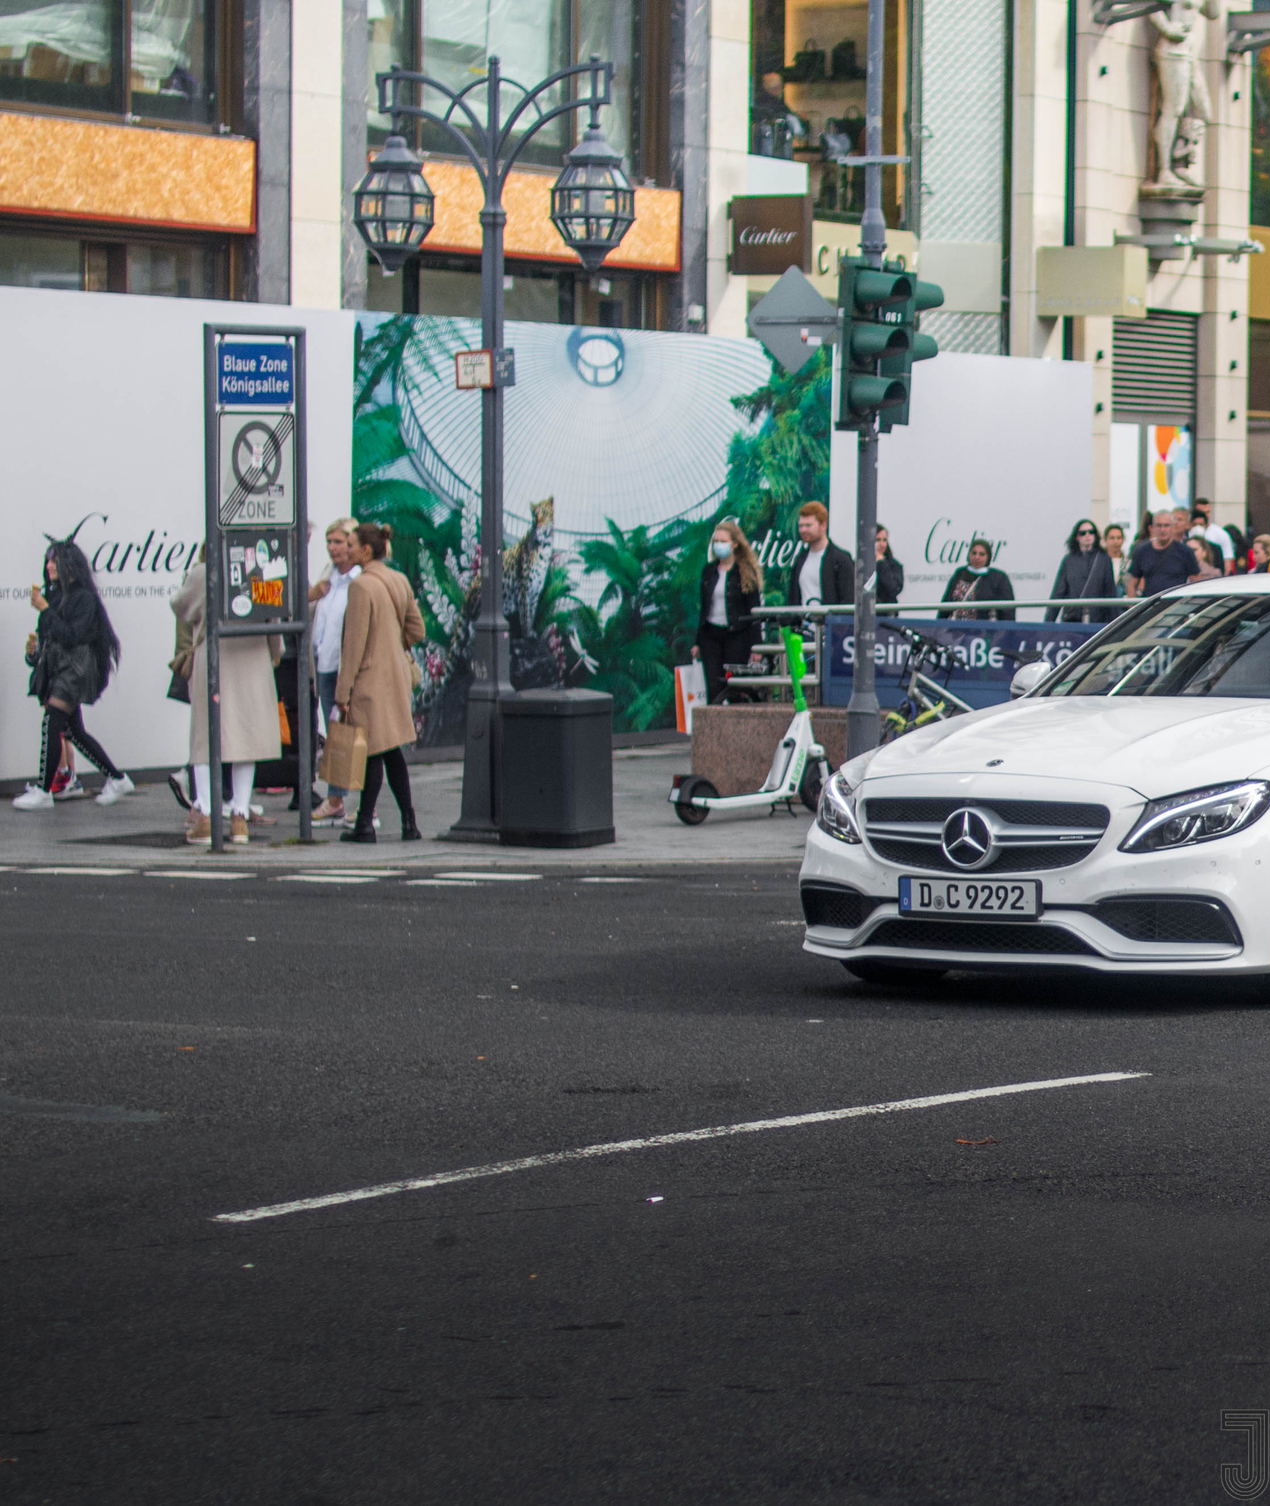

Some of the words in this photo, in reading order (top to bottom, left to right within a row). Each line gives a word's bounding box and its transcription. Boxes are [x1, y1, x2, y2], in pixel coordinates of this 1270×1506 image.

[739, 225, 797, 246] Cartier
[223, 355, 257, 373] Blaue
[260, 355, 288, 373] Zone
[222, 376, 289, 397] Königsallee
[238, 500, 276, 519] ZONE
[134, 586, 147, 597] ON
[150, 585, 164, 597] THE
[919, 882, 932, 908] D
[946, 883, 960, 909] C
[965, 884, 1025, 911] 9292
